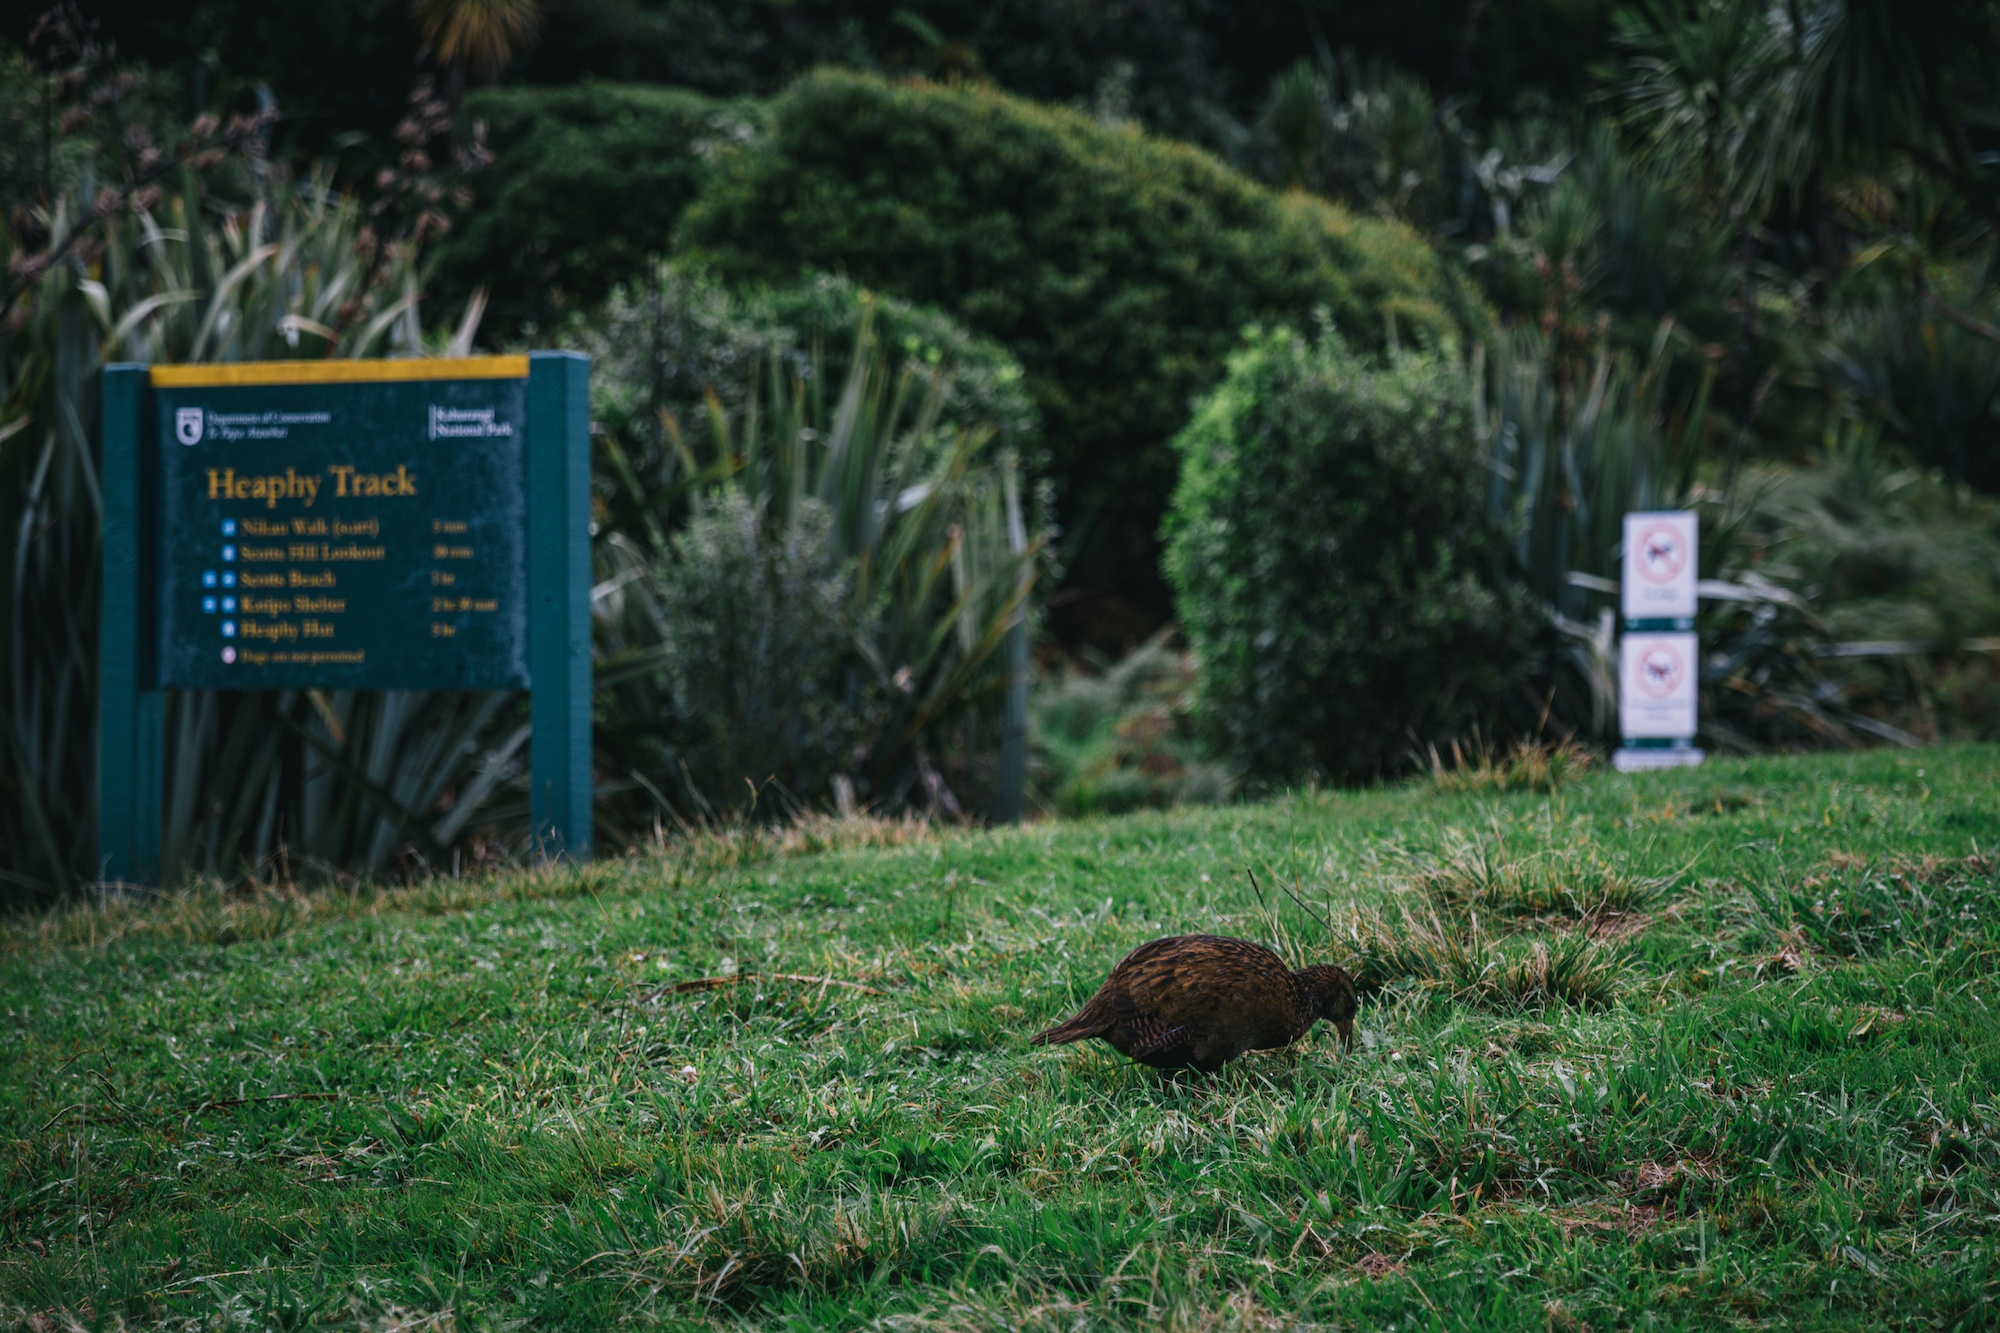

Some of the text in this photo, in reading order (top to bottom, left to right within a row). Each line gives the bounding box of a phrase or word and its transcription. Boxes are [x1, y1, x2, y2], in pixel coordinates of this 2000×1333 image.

[275, 409, 331, 424] Conservation
[436, 420, 513, 437] National Park
[207, 463, 418, 508] Heaphy Track
[290, 516, 329, 536] Walk
[288, 542, 319, 561] Hill
[321, 542, 385, 561] Lookout
[288, 568, 337, 588] Beach
[293, 594, 346, 613] Shelter
[240, 618, 334, 643] Heaphy Hut
